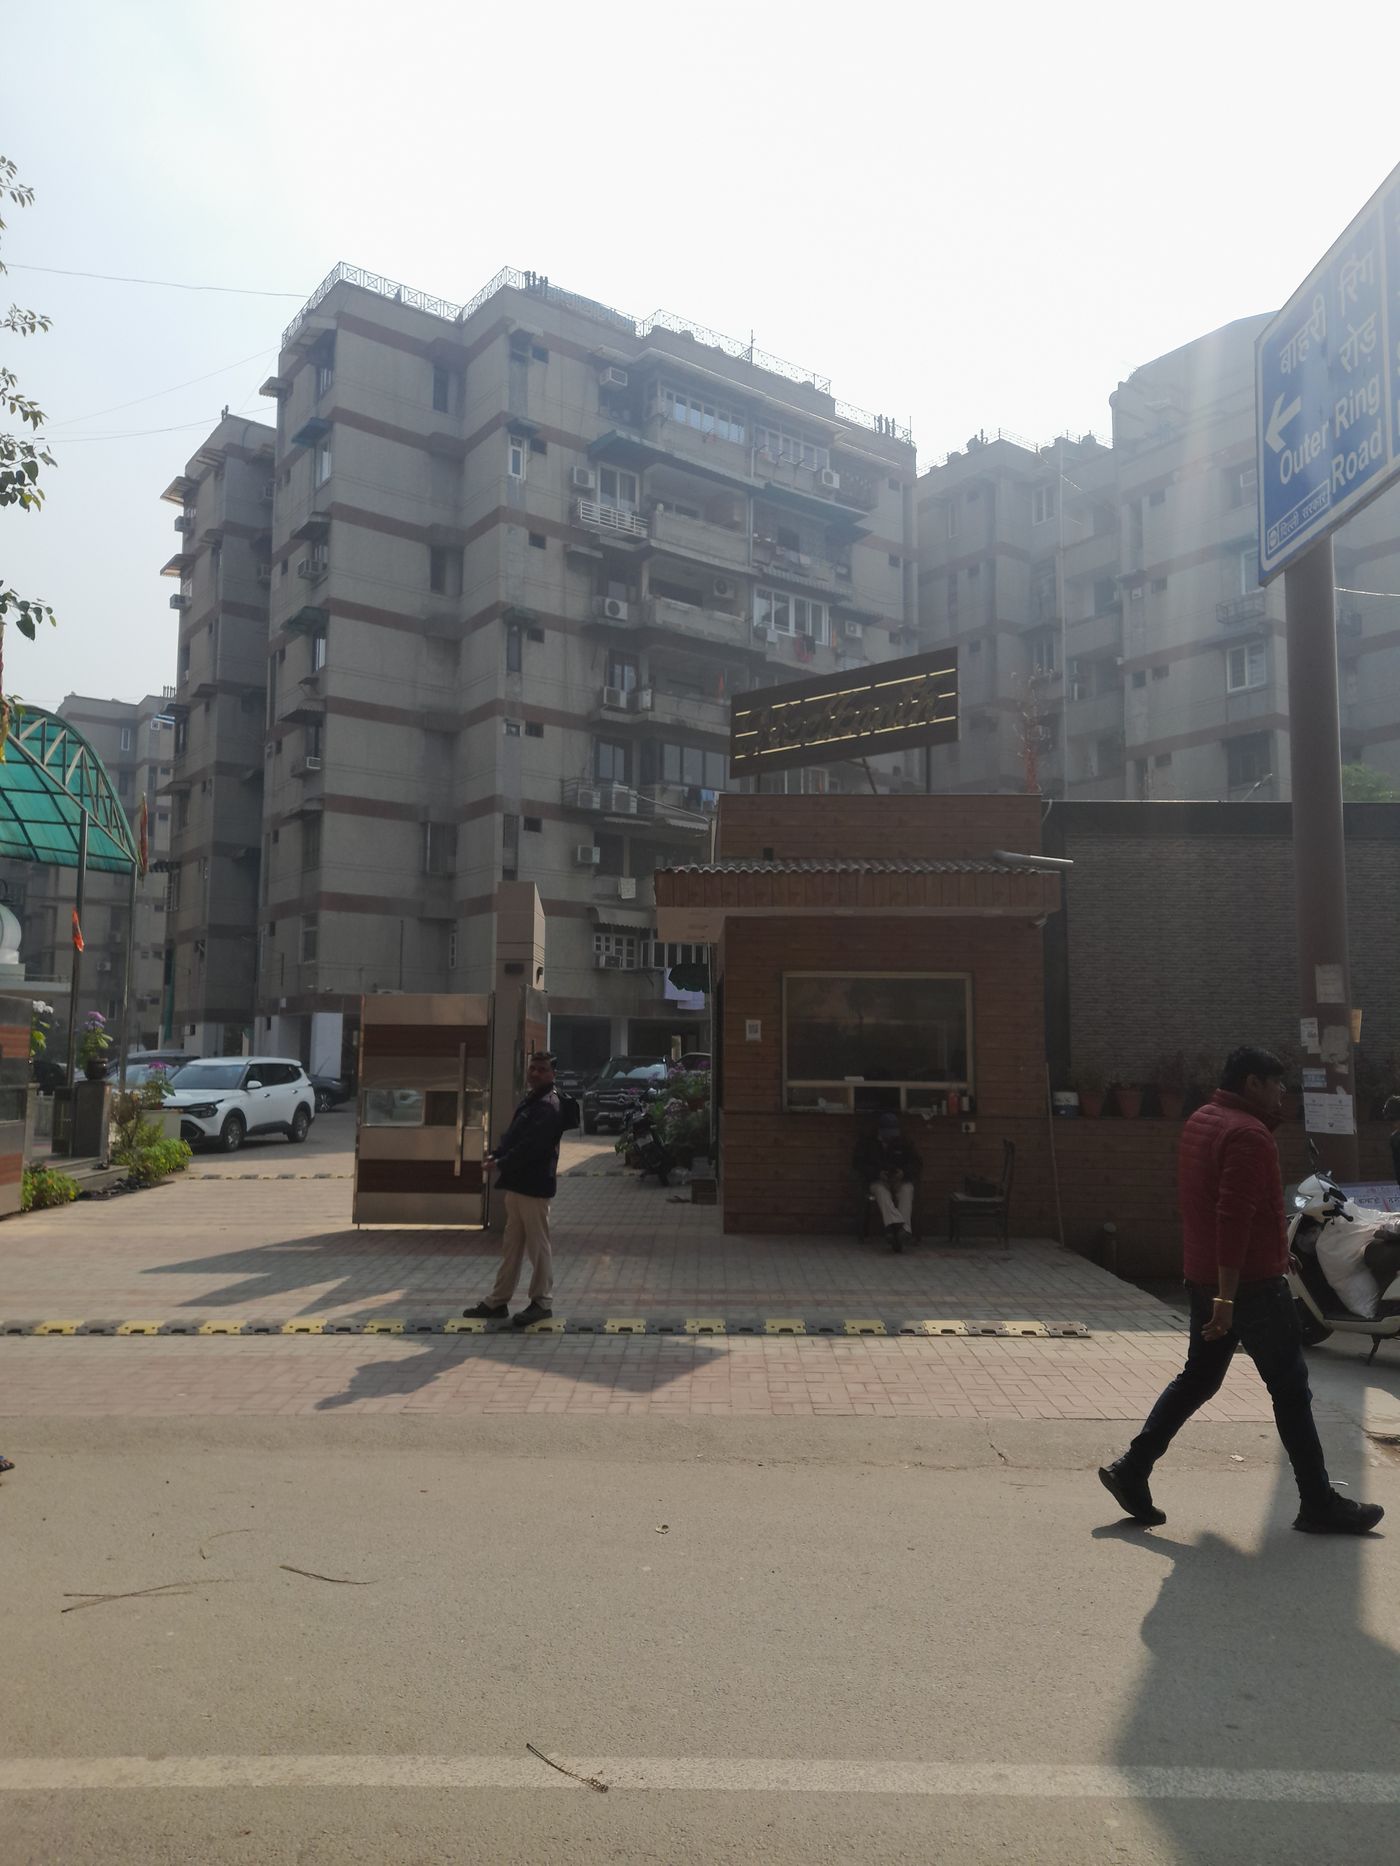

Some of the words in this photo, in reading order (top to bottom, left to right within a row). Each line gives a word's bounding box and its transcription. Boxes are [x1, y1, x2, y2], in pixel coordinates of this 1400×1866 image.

[1279, 292, 1327, 375] बाहरी
[1338, 247, 1375, 318] रिंग
[1279, 420, 1329, 485] Outer
[1335, 374, 1380, 438] Ring
[1331, 417, 1382, 494] Road
